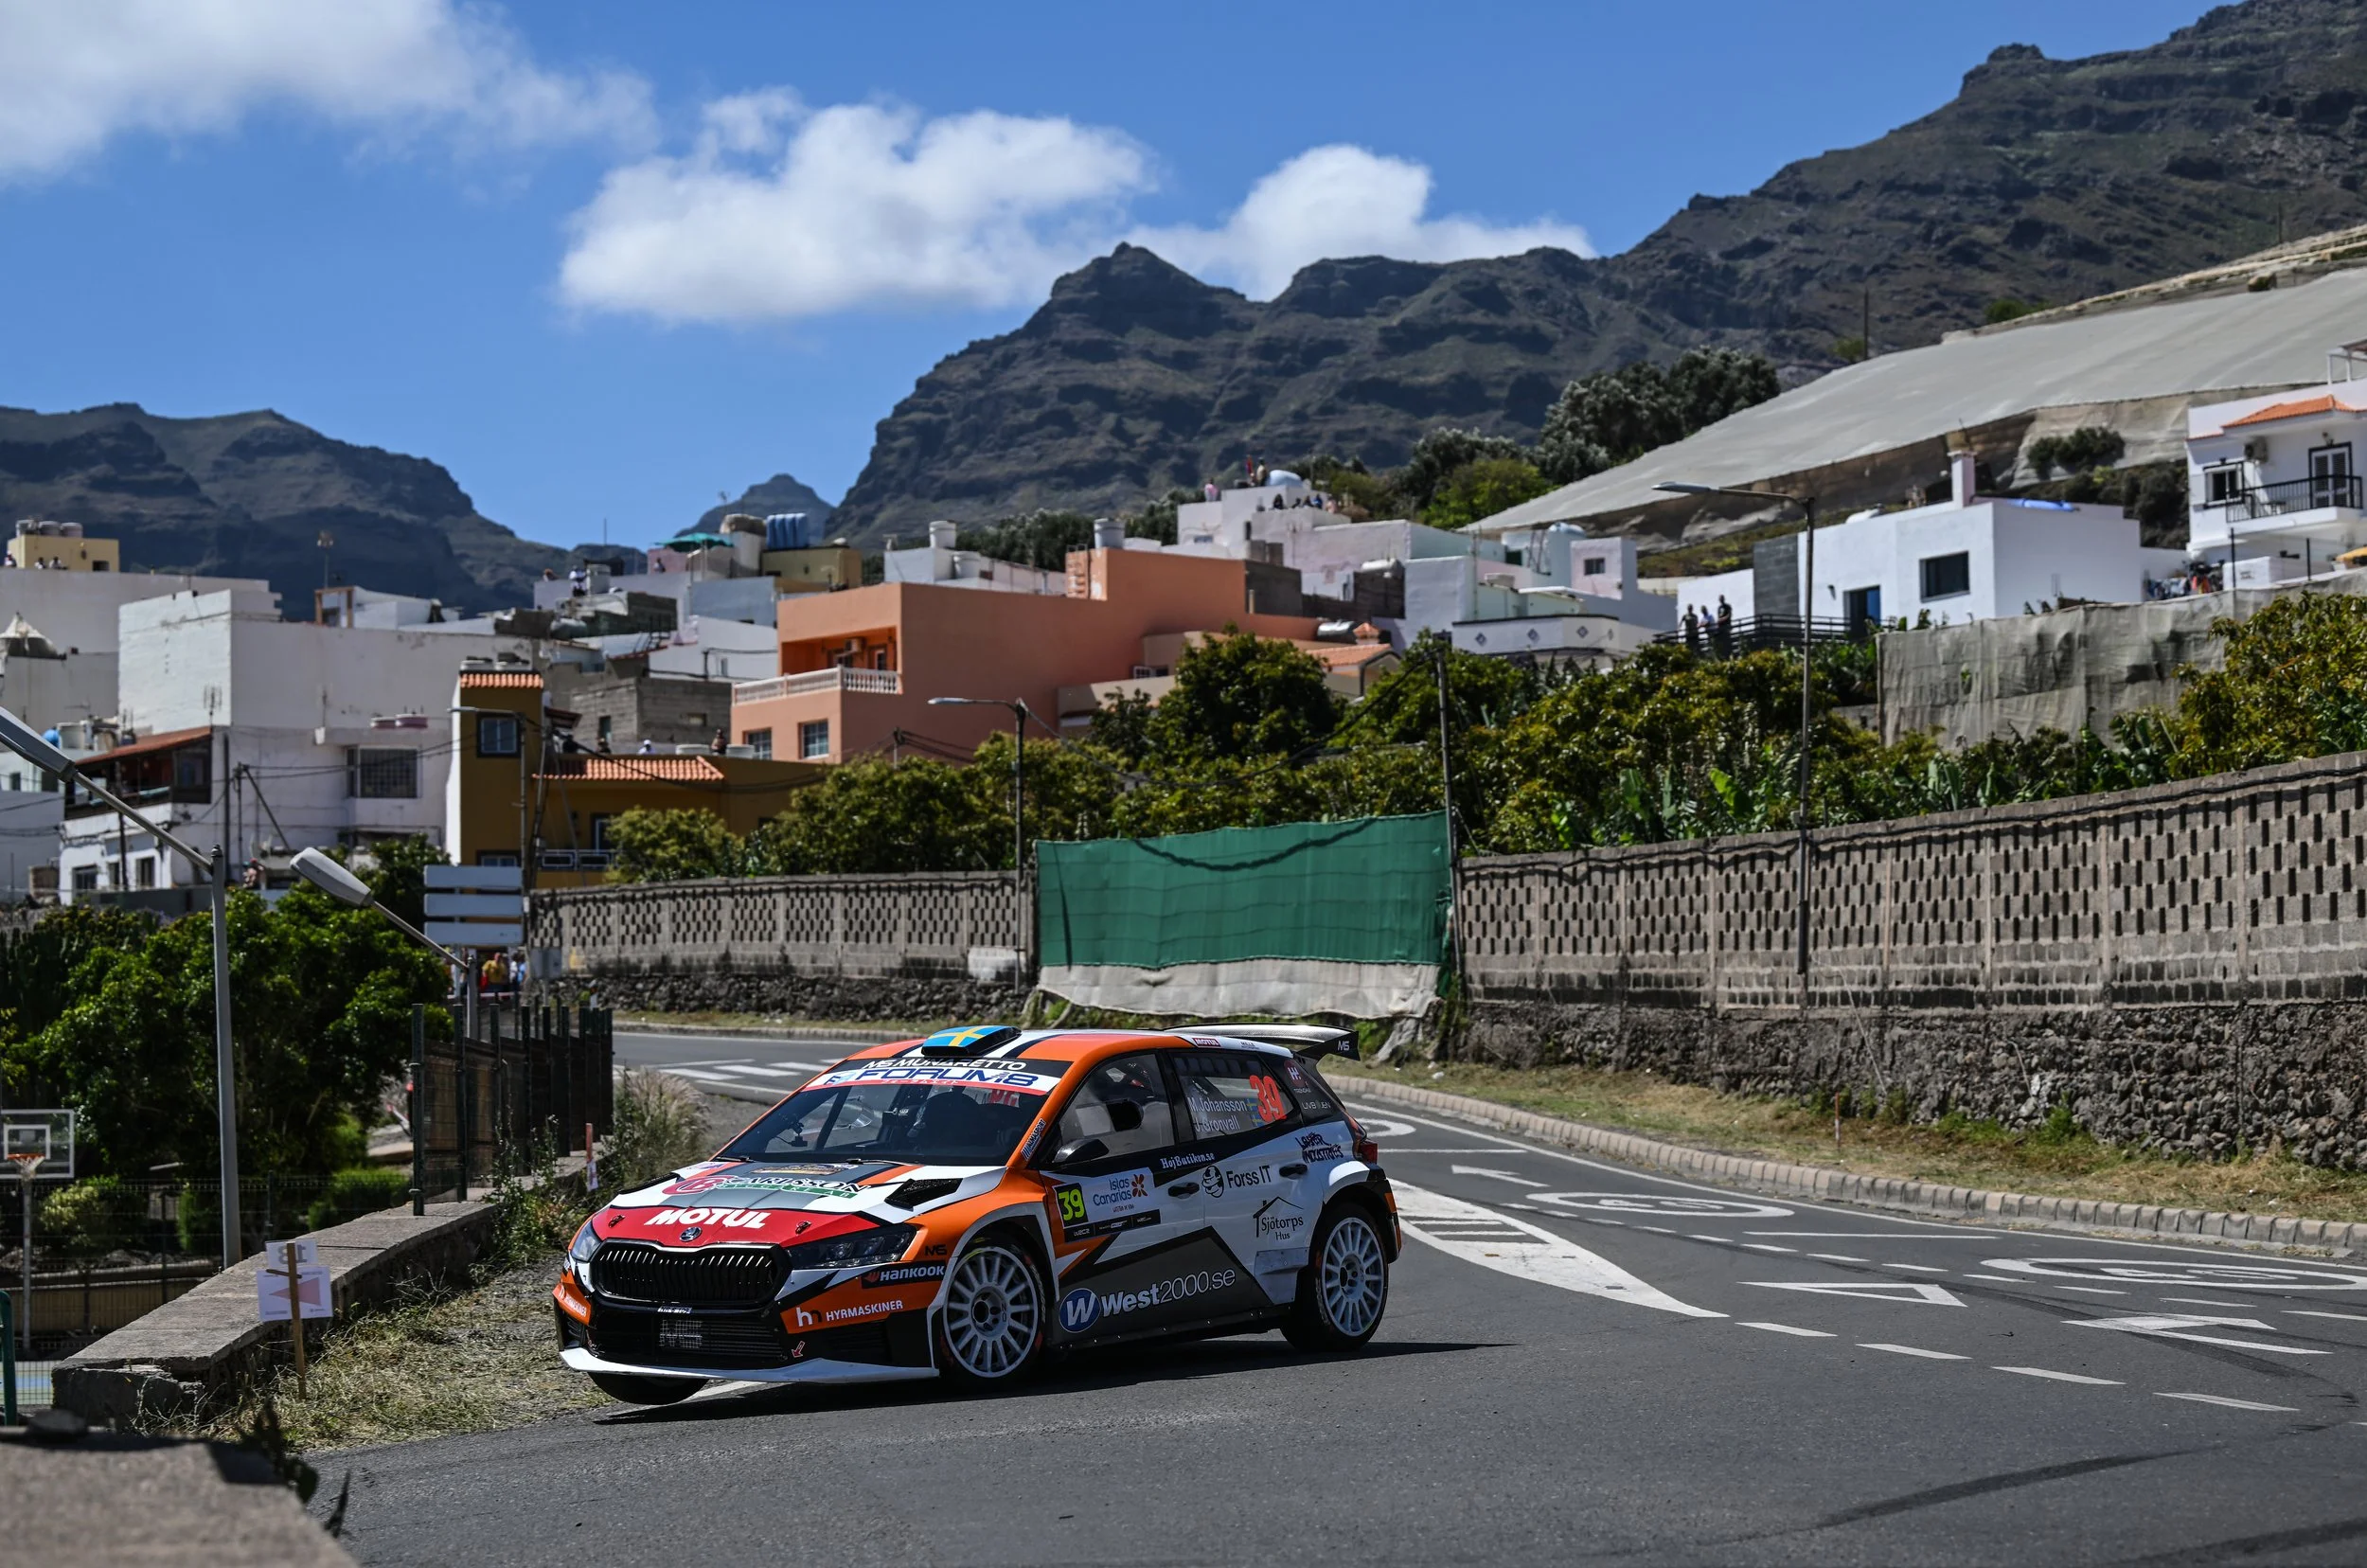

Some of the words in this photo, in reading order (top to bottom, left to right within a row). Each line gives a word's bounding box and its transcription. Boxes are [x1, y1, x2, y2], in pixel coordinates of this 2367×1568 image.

[1195, 1038, 1219, 1046] MOTUL
[1338, 1041, 1350, 1051] MS
[897, 1059, 1027, 1071] MUNARETTO
[1249, 1075, 1287, 1123] 39
[1109, 1177, 1130, 1191] Islas
[1226, 1170, 1259, 1188] Forss
[1259, 1165, 1272, 1184] IT
[1058, 1188, 1085, 1221] 39
[1093, 1189, 1132, 1206] Canarias
[644, 1207, 772, 1229] MOTUL
[1261, 1215, 1304, 1235] Sjötorps
[1275, 1231, 1290, 1240] Hus
[1101, 1269, 1236, 1317] West2000.se
[826, 1299, 904, 1322] HYRMASKINER
